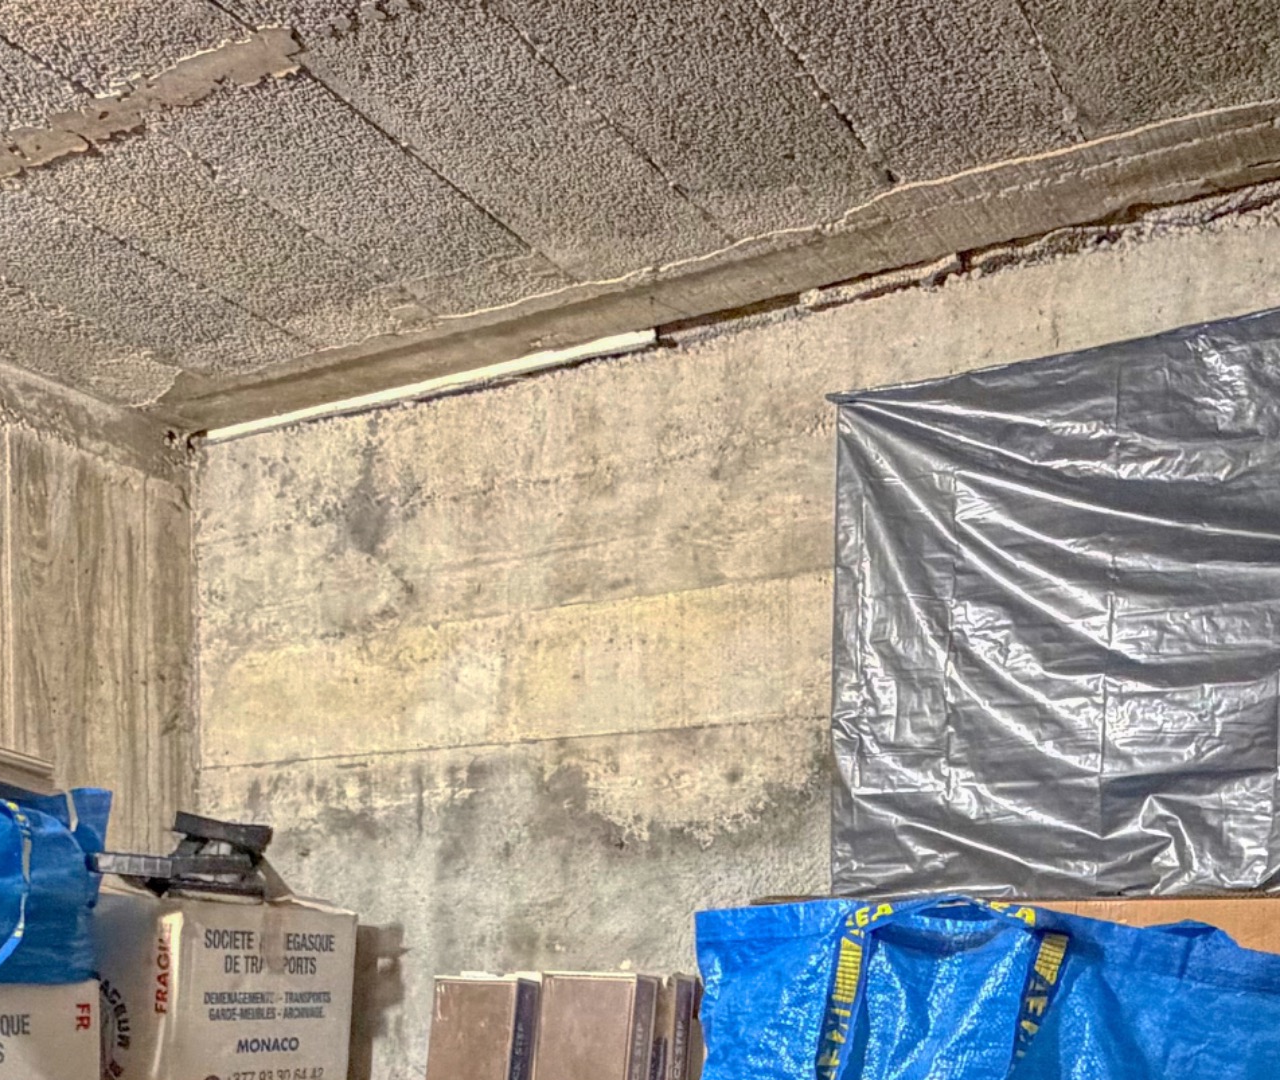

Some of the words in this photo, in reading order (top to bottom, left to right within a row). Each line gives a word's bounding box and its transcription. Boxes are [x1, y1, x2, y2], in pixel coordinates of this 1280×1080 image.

[204, 929, 255, 950] SOCIETE
[224, 955, 241, 975] DE
[236, 1037, 300, 1053] MONACO
[674, 1021, 684, 1055] STEP
